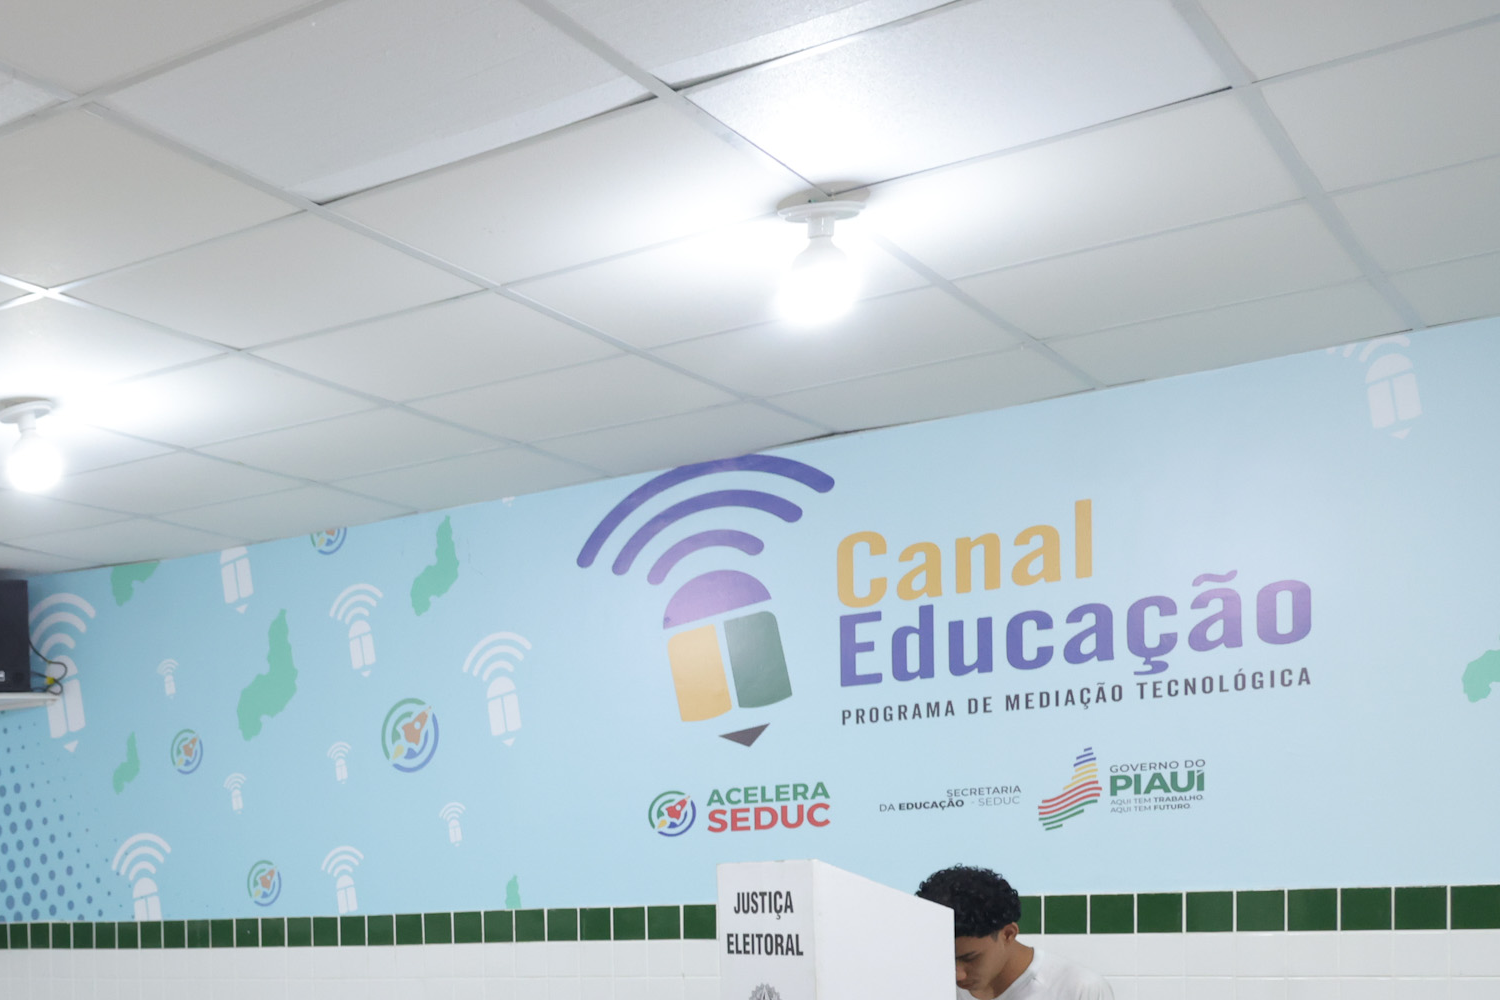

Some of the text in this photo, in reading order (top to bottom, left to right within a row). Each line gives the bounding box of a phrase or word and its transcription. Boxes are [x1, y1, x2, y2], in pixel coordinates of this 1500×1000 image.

[836, 498, 1093, 608] Canal
[839, 570, 1312, 687] Educação
[841, 667, 1311, 726] PROGRAMA DE MEDIAÇÃO TECNOLÓGICA
[1109, 759, 1206, 773] GOVERNO DO
[706, 781, 832, 806] ACELERA
[946, 785, 1021, 798] SECRETARIA
[1110, 798, 1132, 806] AQUI
[879, 803, 896, 812] DA
[898, 798, 965, 811] EDUCAÇÃO
[978, 796, 1020, 807] SEDUC
[1110, 806, 1132, 814] AQUI
[1134, 804, 1152, 812] TEM
[707, 803, 831, 833] SEDUC
[733, 890, 794, 920] JUSTIÇA
[726, 933, 804, 956] ELEITORAL
